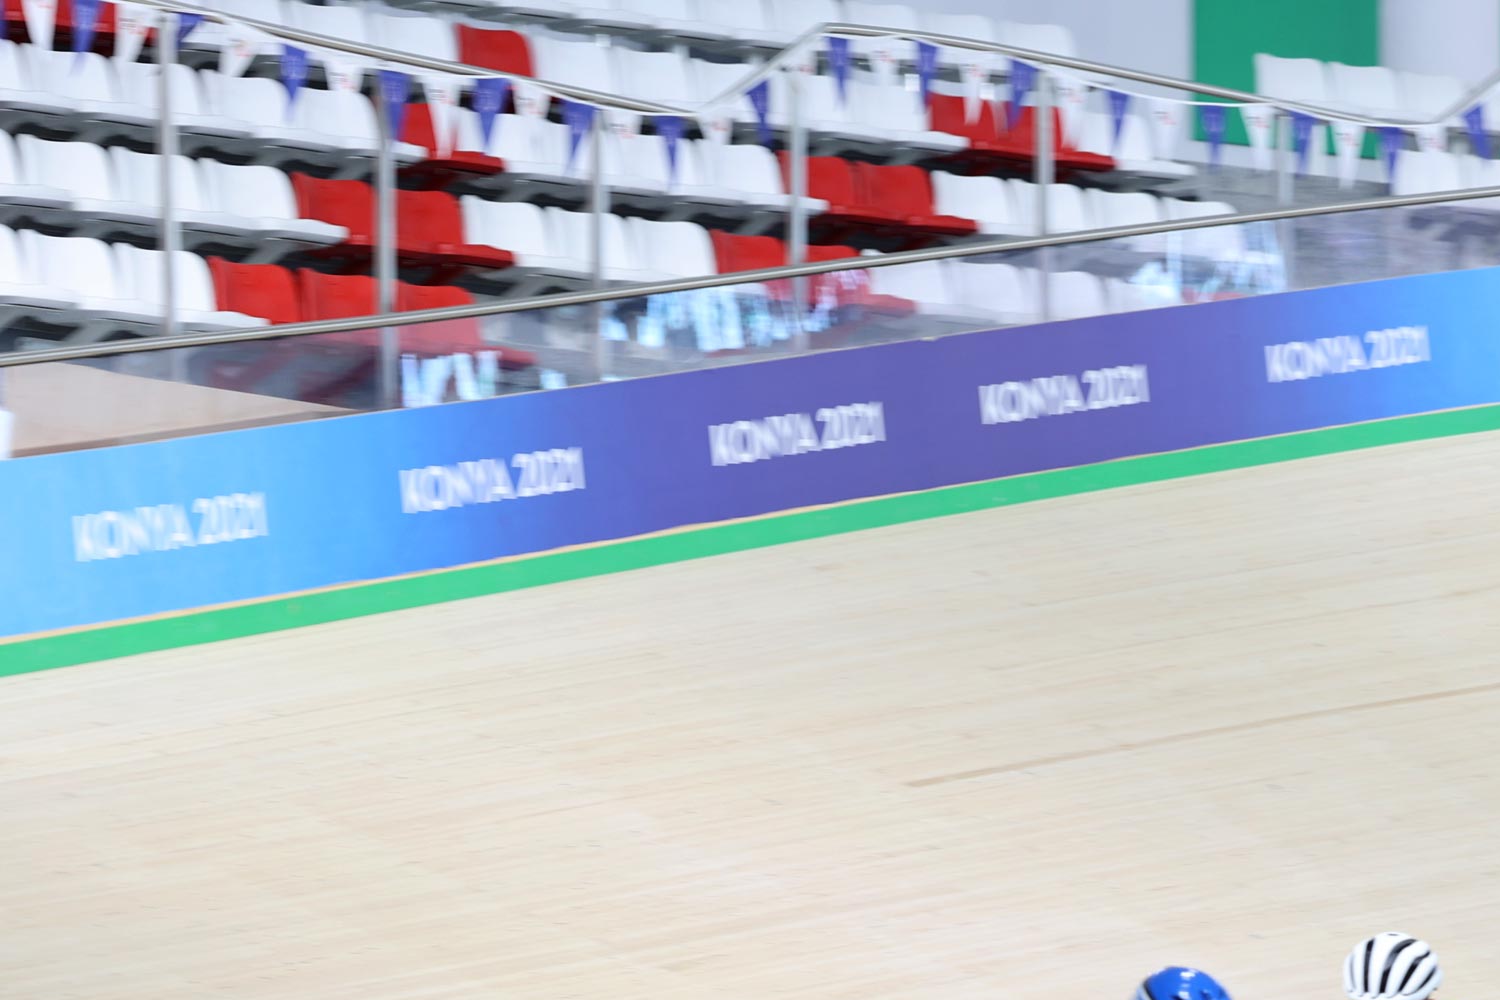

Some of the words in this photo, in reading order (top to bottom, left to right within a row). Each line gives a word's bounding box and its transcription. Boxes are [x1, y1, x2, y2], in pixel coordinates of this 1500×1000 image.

[1264, 335, 1367, 383] KONYA
[1362, 325, 1433, 367] 2021
[978, 374, 1084, 425] KONYA
[1080, 364, 1150, 408] 2021
[708, 411, 815, 467] KONYA
[812, 401, 886, 447] 2021
[399, 458, 517, 514] KONYA
[511, 446, 588, 498] 2021
[71, 504, 196, 562] KONYA
[191, 492, 269, 545] 2021
